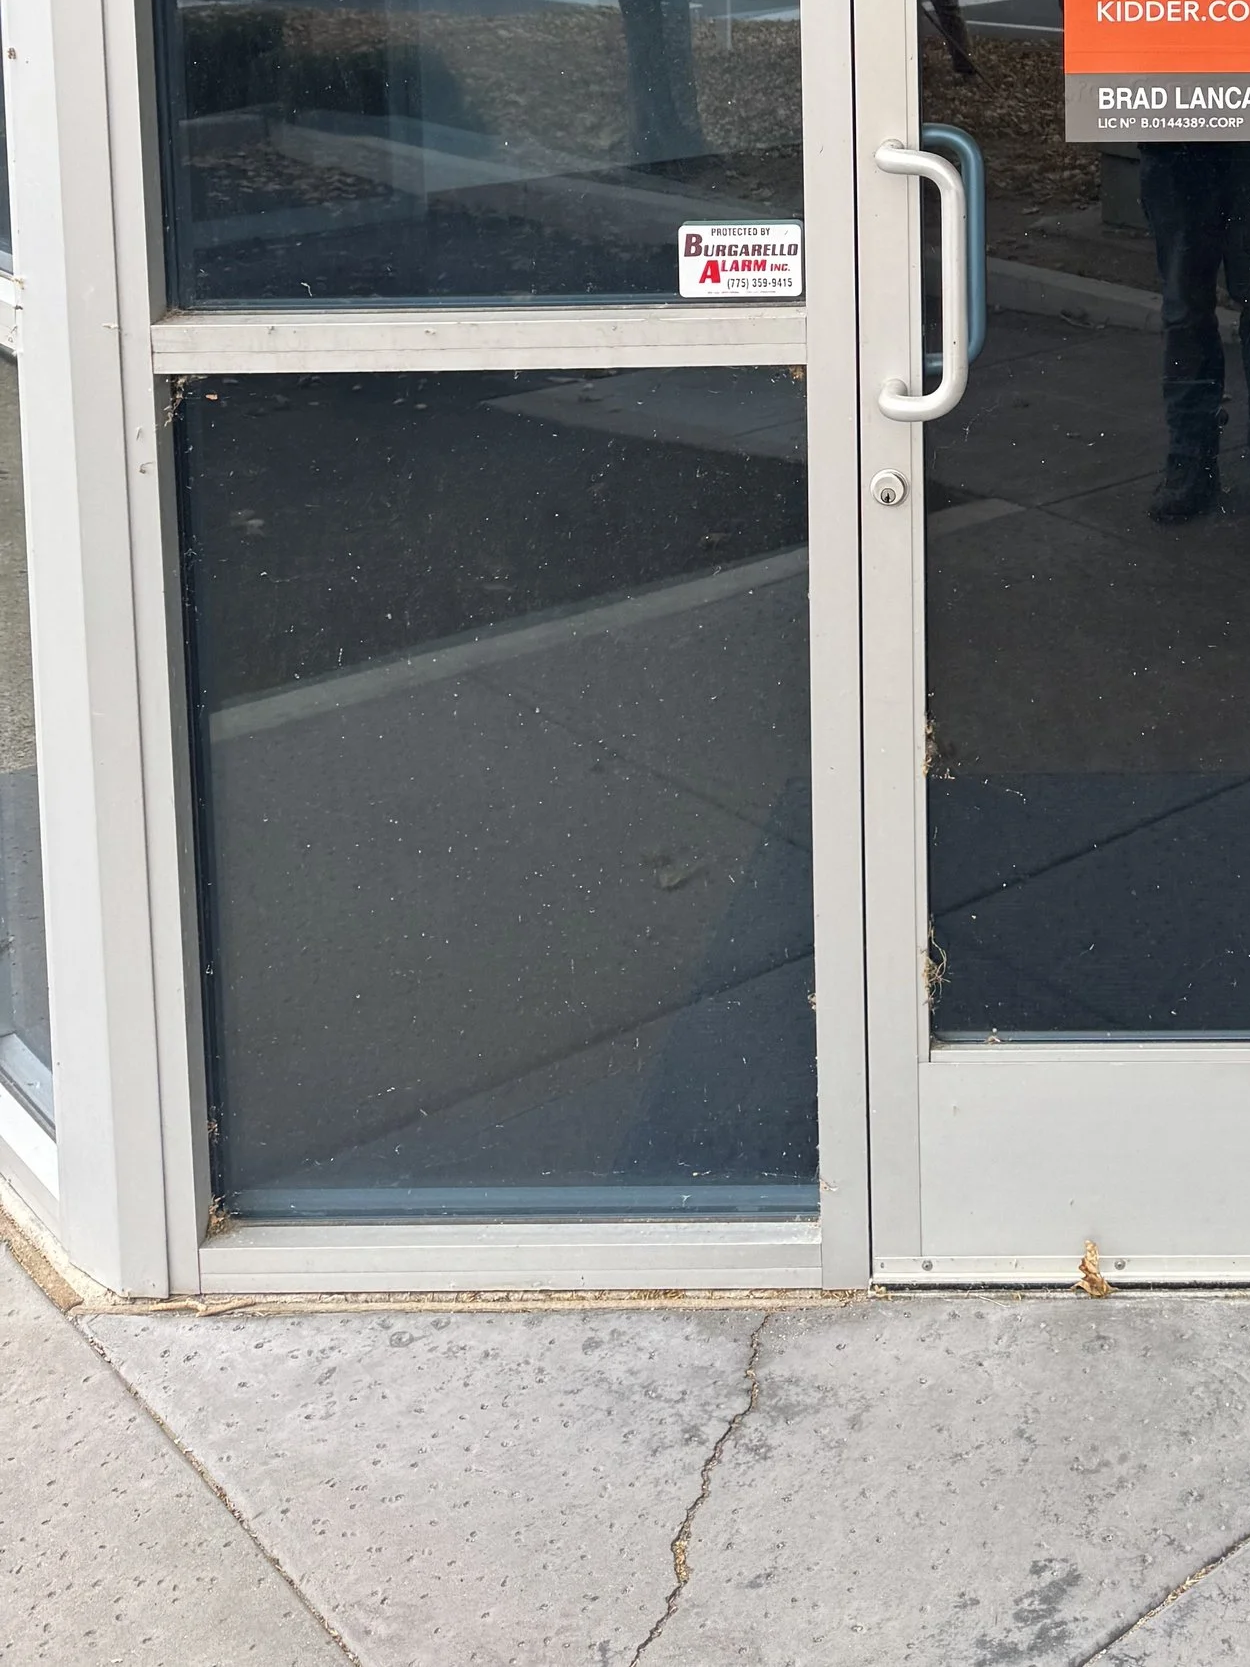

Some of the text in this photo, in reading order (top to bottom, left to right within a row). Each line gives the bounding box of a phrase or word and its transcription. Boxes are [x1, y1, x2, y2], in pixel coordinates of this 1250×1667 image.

[1098, 87, 1168, 110] BRAD
[1098, 117, 1118, 129] LIC
[1140, 116, 1244, 129] B.0144389.CORP
[711, 227, 771, 236] PROTECTED BY
[684, 233, 798, 257] BURGARELLO
[699, 259, 791, 284] ALARM INC.
[727, 277, 793, 290] (775) 359-9415
